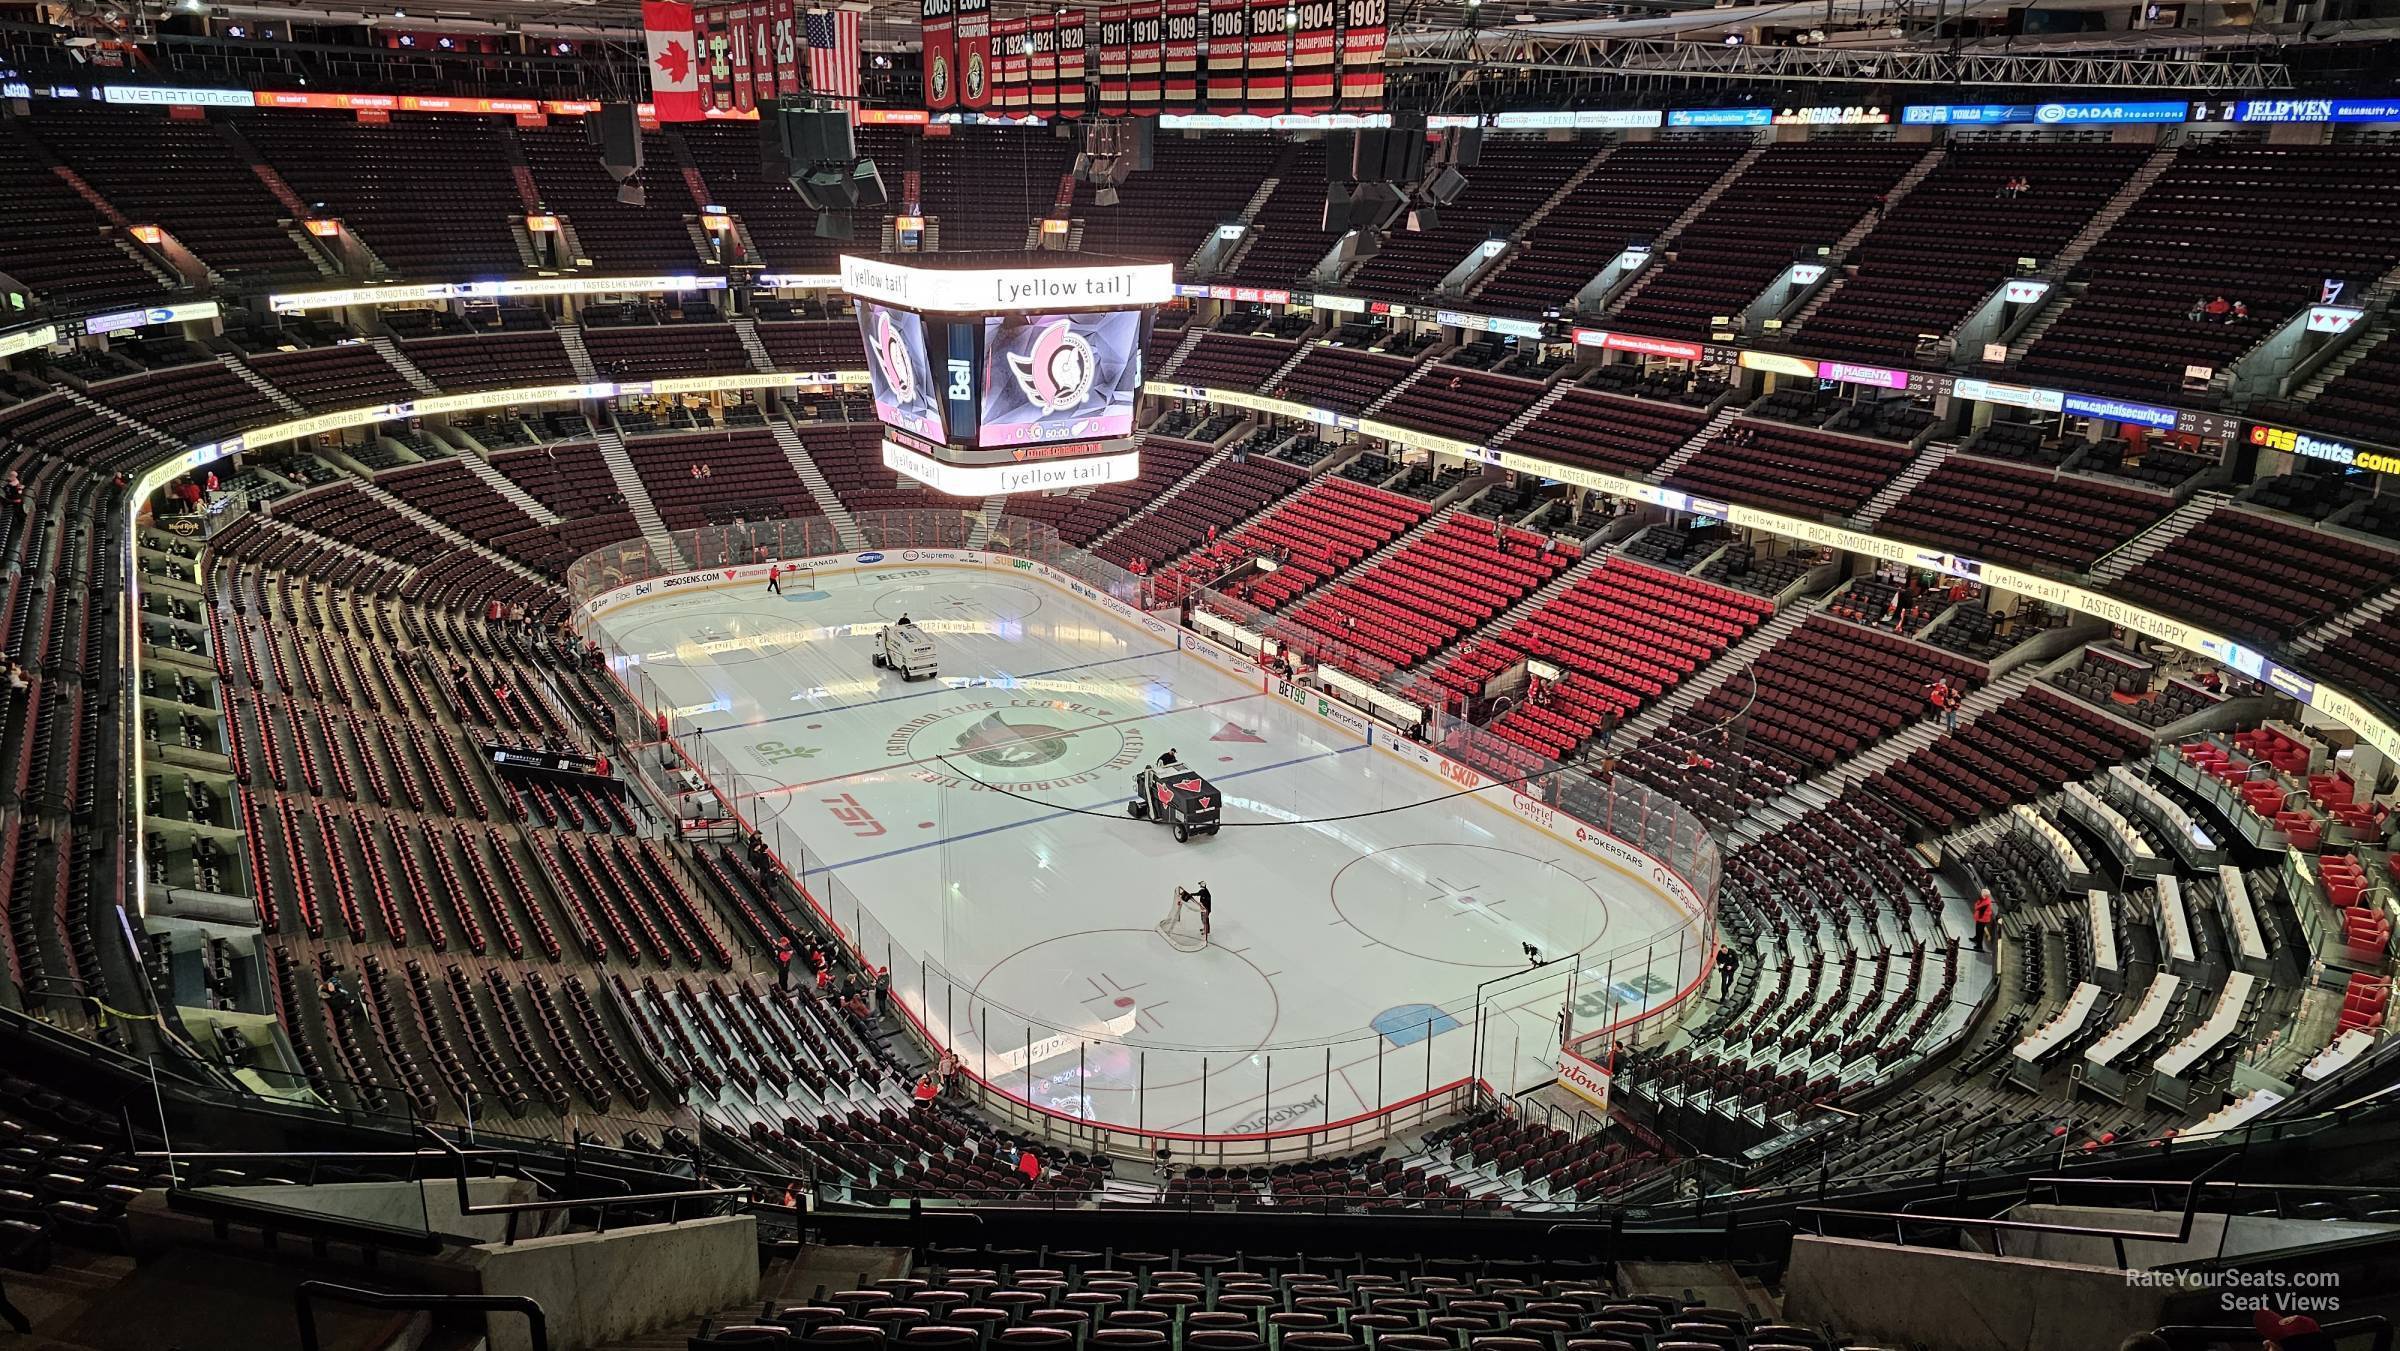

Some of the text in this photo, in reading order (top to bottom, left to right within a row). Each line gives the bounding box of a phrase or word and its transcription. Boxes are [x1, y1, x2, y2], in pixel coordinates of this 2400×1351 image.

[1252, 8, 1286, 34] 1905
[1298, 2, 1334, 30] 1904
[1348, 0, 1385, 27] 1903
[958, 23, 989, 38] CHAMPIONS
[1133, 20, 1159, 42] 1910
[1168, 17, 1196, 39] 1909
[1211, 11, 1243, 36] 1906
[776, 19, 794, 64] 25
[1033, 31, 1054, 52] 1921
[1060, 28, 1083, 49] 1920
[1102, 23, 1125, 45] 1911
[1295, 35, 1334, 50] CHAMPIONS
[1345, 32, 1385, 49] CHAMPIONS
[733, 25, 748, 67] 11
[757, 23, 767, 67] 4
[992, 37, 1001, 56] 27
[1005, 34, 1026, 56] 1923
[1166, 45, 1197, 58] CHAMPIONS
[1210, 42, 1243, 55] CHAMPIONS
[1250, 40, 1286, 54] CHAMPIONS
[1060, 54, 1085, 65] CHAMPIONS
[1100, 50, 1127, 61] CHAMPIONS
[1131, 48, 1160, 61] CHAMPIONS
[108, 89, 251, 104] LIVENATION.com
[1799, 106, 1864, 124] SIGNS.CA
[2066, 107, 2123, 119] GADAR
[2386, 107, 2399, 116] for
[376, 288, 408, 299] SMOOTH
[410, 287, 425, 297] RED
[583, 281, 611, 290] TASTES
[738, 376, 771, 387] SMOOTH
[772, 376, 787, 386] RED
[948, 358, 971, 401] Bell
[1844, 364, 1892, 381] MAGENTA
[1910, 374, 1953, 386] 309 310
[481, 392, 510, 404] TASTES
[511, 391, 528, 402] LIKE
[530, 389, 559, 400] HAPPY
[1909, 382, 1951, 395] 209 210
[318, 416, 347, 430] SMOOTH
[348, 412, 364, 424] RED
[2065, 398, 2175, 426] www.capitalsecurity.ca
[2182, 412, 2237, 429] 310 311
[1016, 422, 1099, 439] 0 60:00 0
[2179, 422, 2235, 439] 210 211
[1559, 468, 1586, 485] TASTES
[1586, 473, 1603, 488] LIKE
[1603, 477, 1630, 493] HAPPY
[1837, 530, 1881, 556] SMOOTH
[1882, 541, 1904, 560] RED
[808, 558, 839, 569] CANADA
[992, 555, 1034, 571] SUBWAY
[636, 582, 652, 596] Bell
[663, 572, 720, 588] 5050SENS.COM
[2081, 594, 2121, 620] TASTES
[2123, 609, 2146, 630] LIKE
[2148, 619, 2188, 644] HAPPY
[1196, 643, 1219, 660] Supreme
[1278, 680, 1306, 706] BET99
[1319, 701, 1363, 730] enterprise
[886, 712, 942, 758] CANADIAN
[942, 700, 996, 716] TIRE
[1451, 764, 1480, 789] SKIP
[1512, 793, 1554, 822] Gabriel
[1588, 834, 1643, 868] POKERSTARS
[1558, 1062, 1605, 1097] ortons
